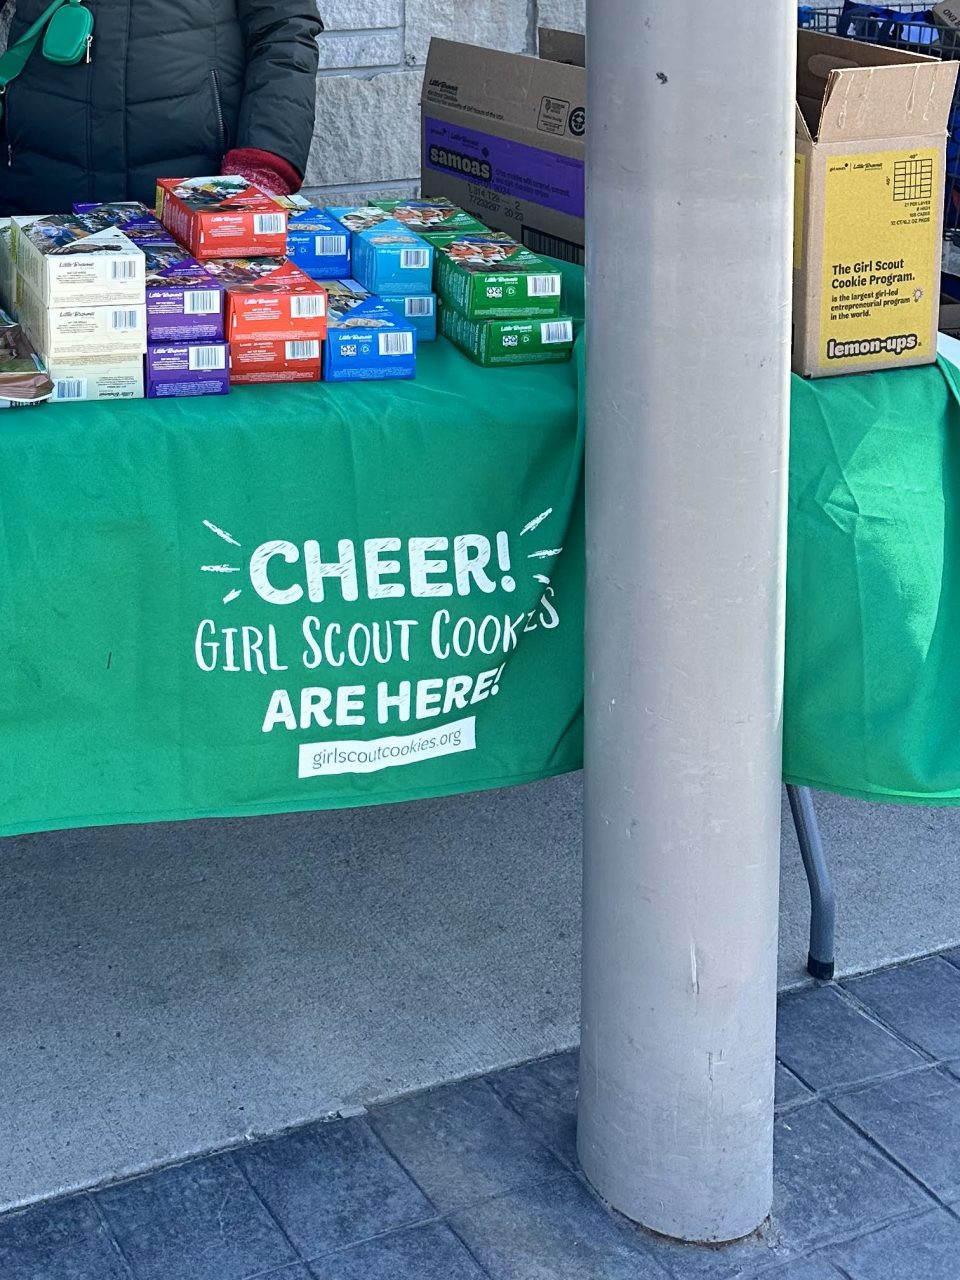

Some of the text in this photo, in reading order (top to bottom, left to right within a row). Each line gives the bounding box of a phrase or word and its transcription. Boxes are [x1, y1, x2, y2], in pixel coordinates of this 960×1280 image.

[943, 8, 958, 22] END
[429, 146, 491, 180] samoas
[514, 201, 521, 210] 2
[832, 258, 904, 275] The Girl Scout
[831, 274, 867, 289] Cookie
[831, 288, 898, 303] is the largest girl-led
[830, 297, 910, 312] entrepreneurial program
[838, 312, 850, 320] the
[850, 310, 871, 319] world.
[828, 335, 917, 358] lemon-ups
[249, 530, 516, 605] CHEER!
[194, 619, 289, 675] GIRL
[302, 615, 419, 669] SCOUT
[261, 662, 506, 733] ARE HERE!
[312, 728, 462, 770] girlscoutcookies.org
